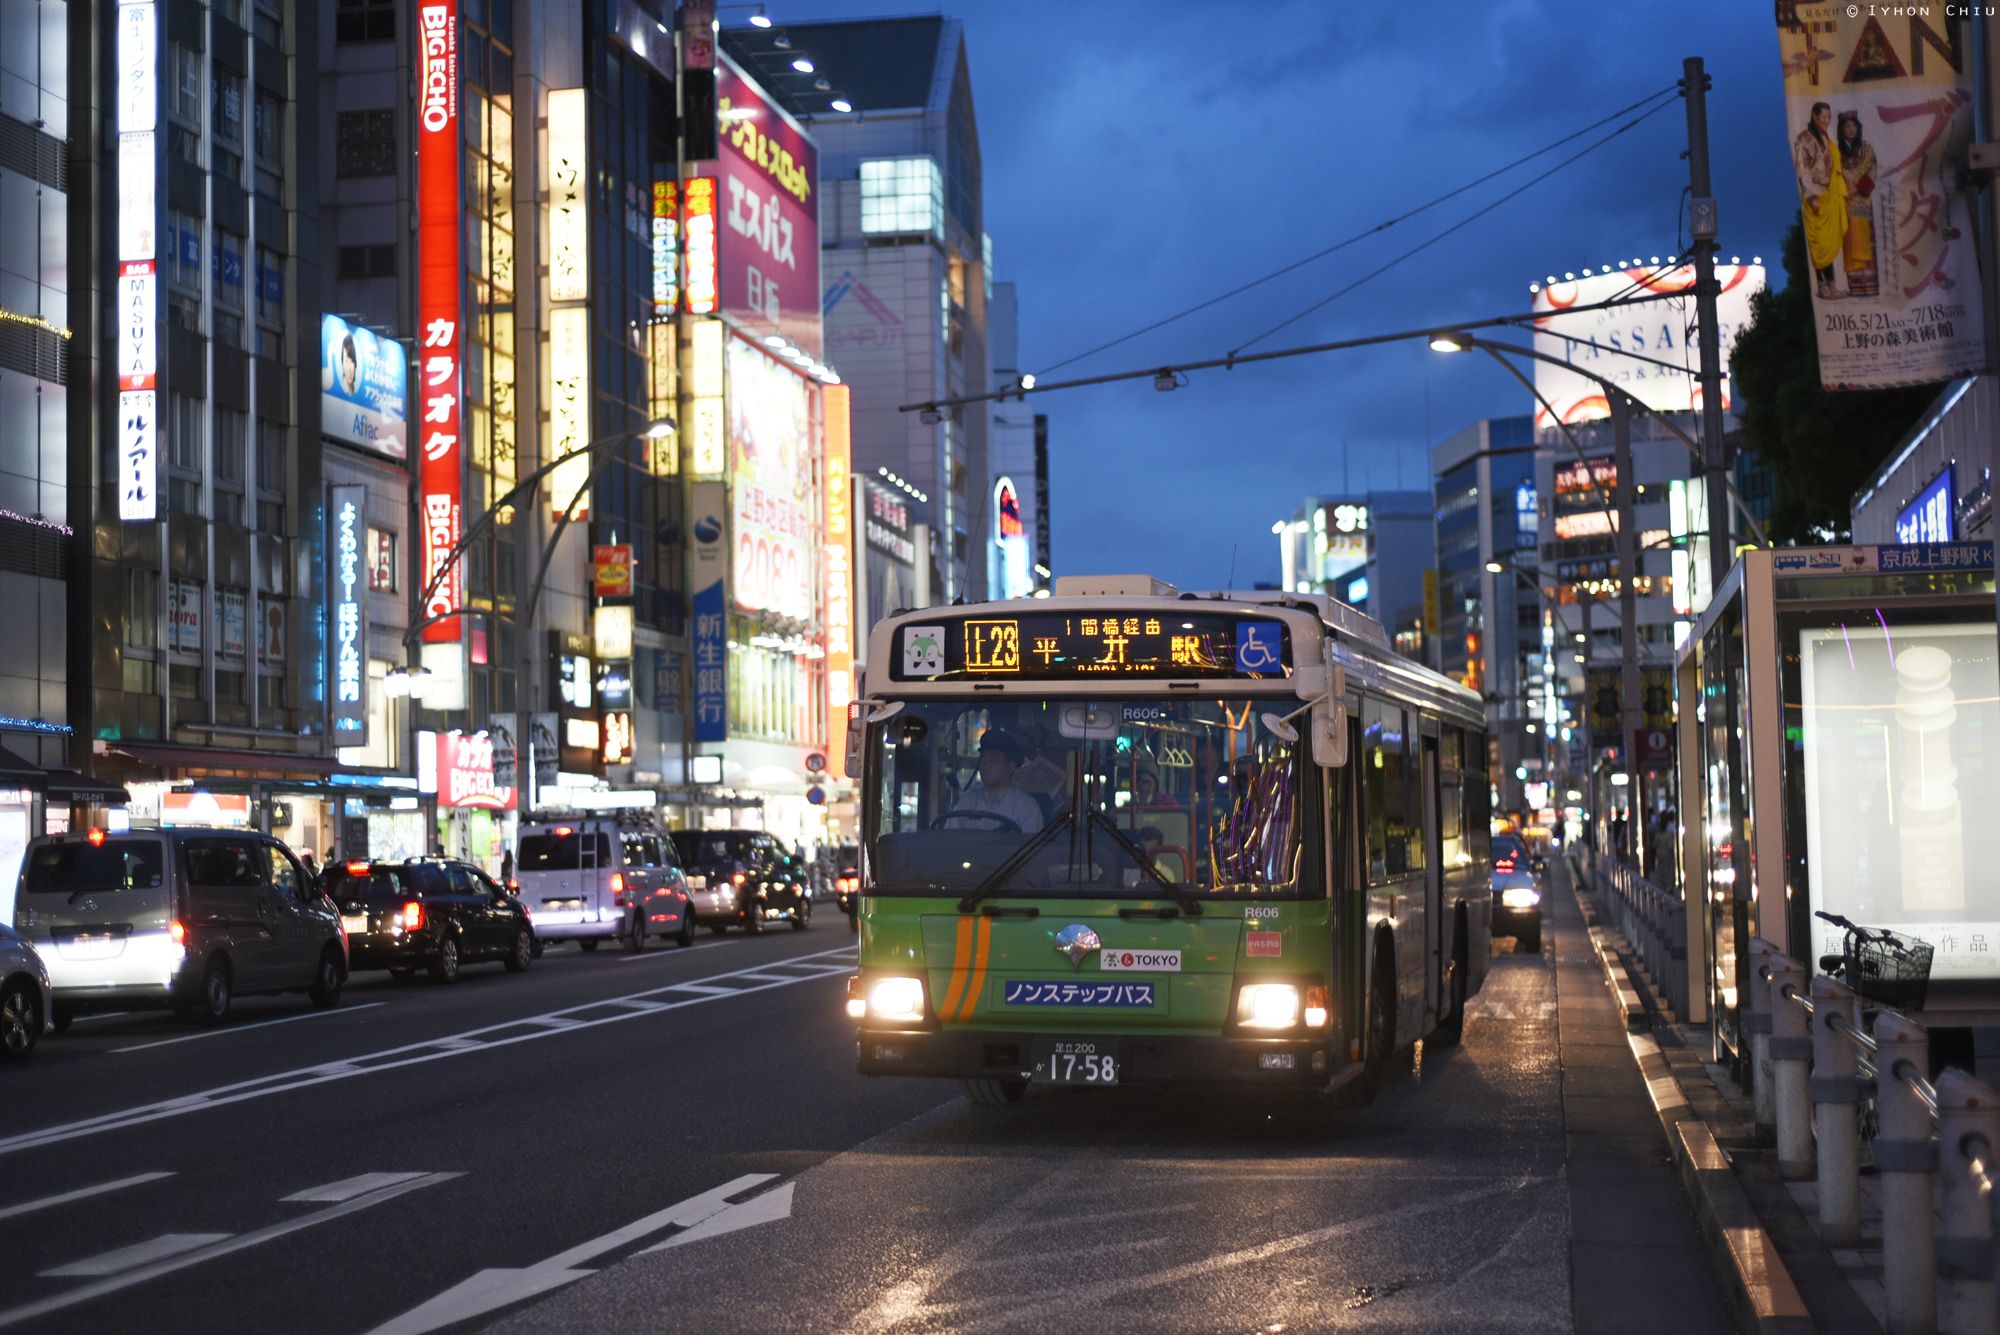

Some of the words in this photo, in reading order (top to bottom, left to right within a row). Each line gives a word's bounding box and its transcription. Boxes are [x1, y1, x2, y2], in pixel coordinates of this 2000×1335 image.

[422, 5, 447, 57] BIG
[448, 16, 456, 52] Karaoke
[423, 58, 448, 133] ECHO
[448, 53, 457, 118] Entertainment
[728, 174, 795, 271] エスパス
[131, 279, 145, 371] MASUYA
[1842, 322, 1954, 350] 上野の森美術館
[425, 318, 456, 461] カラオケ
[353, 413, 379, 440] Aflac
[127, 415, 148, 502] ルノアール
[426, 494, 451, 547] BIG
[741, 531, 797, 600] 2080
[1881, 547, 1979, 569] 京成上野駅
[338, 603, 360, 701] ほけん案内
[697, 613, 723, 724] 新生銀行
[1123, 707, 1159, 720] R606
[450, 768, 476, 803] BIG
[1244, 907, 1279, 918] R606
[1135, 955, 1178, 966] TOKYO
[1248, 940, 1280, 948] PASMO
[1006, 983, 1153, 1004] ノンステップバス
[1051, 1054, 1115, 1081] 17-58
